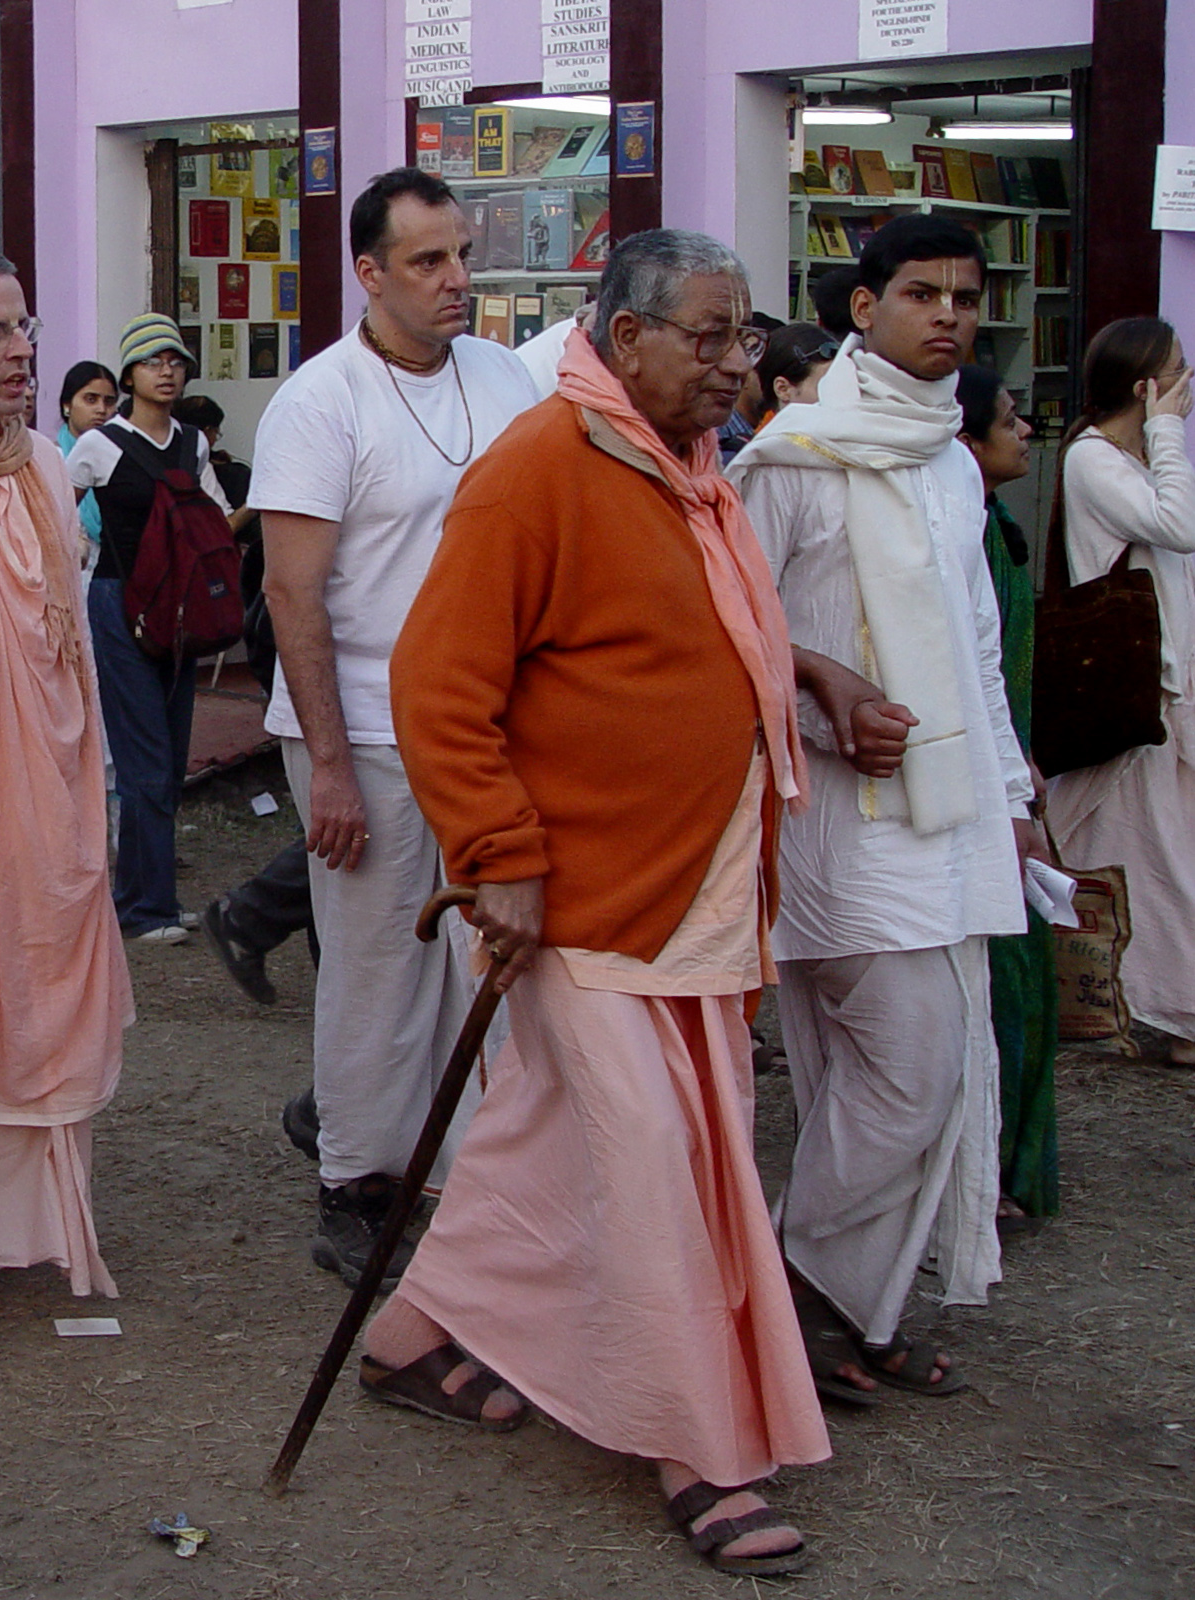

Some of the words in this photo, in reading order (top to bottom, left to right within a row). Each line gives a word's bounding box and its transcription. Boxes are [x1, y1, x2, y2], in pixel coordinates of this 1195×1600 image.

[428, 6, 450, 18] LAW
[554, 6, 603, 22] STUDIES
[417, 23, 460, 38] INDIAN
[550, 20, 607, 37] SANSKRIT
[411, 42, 466, 57] MEDICINE
[410, 59, 470, 74] LINGUISTICS
[555, 56, 606, 67] SOCIOLOGY
[572, 69, 590, 78] AND
[407, 80, 445, 93] MUSIC
[447, 79, 471, 92] AND
[549, 81, 609, 92] ANTHROPOLOG
[420, 93, 461, 106] DANCE
[483, 128, 498, 137] AM
[478, 138, 502, 147] THAT
